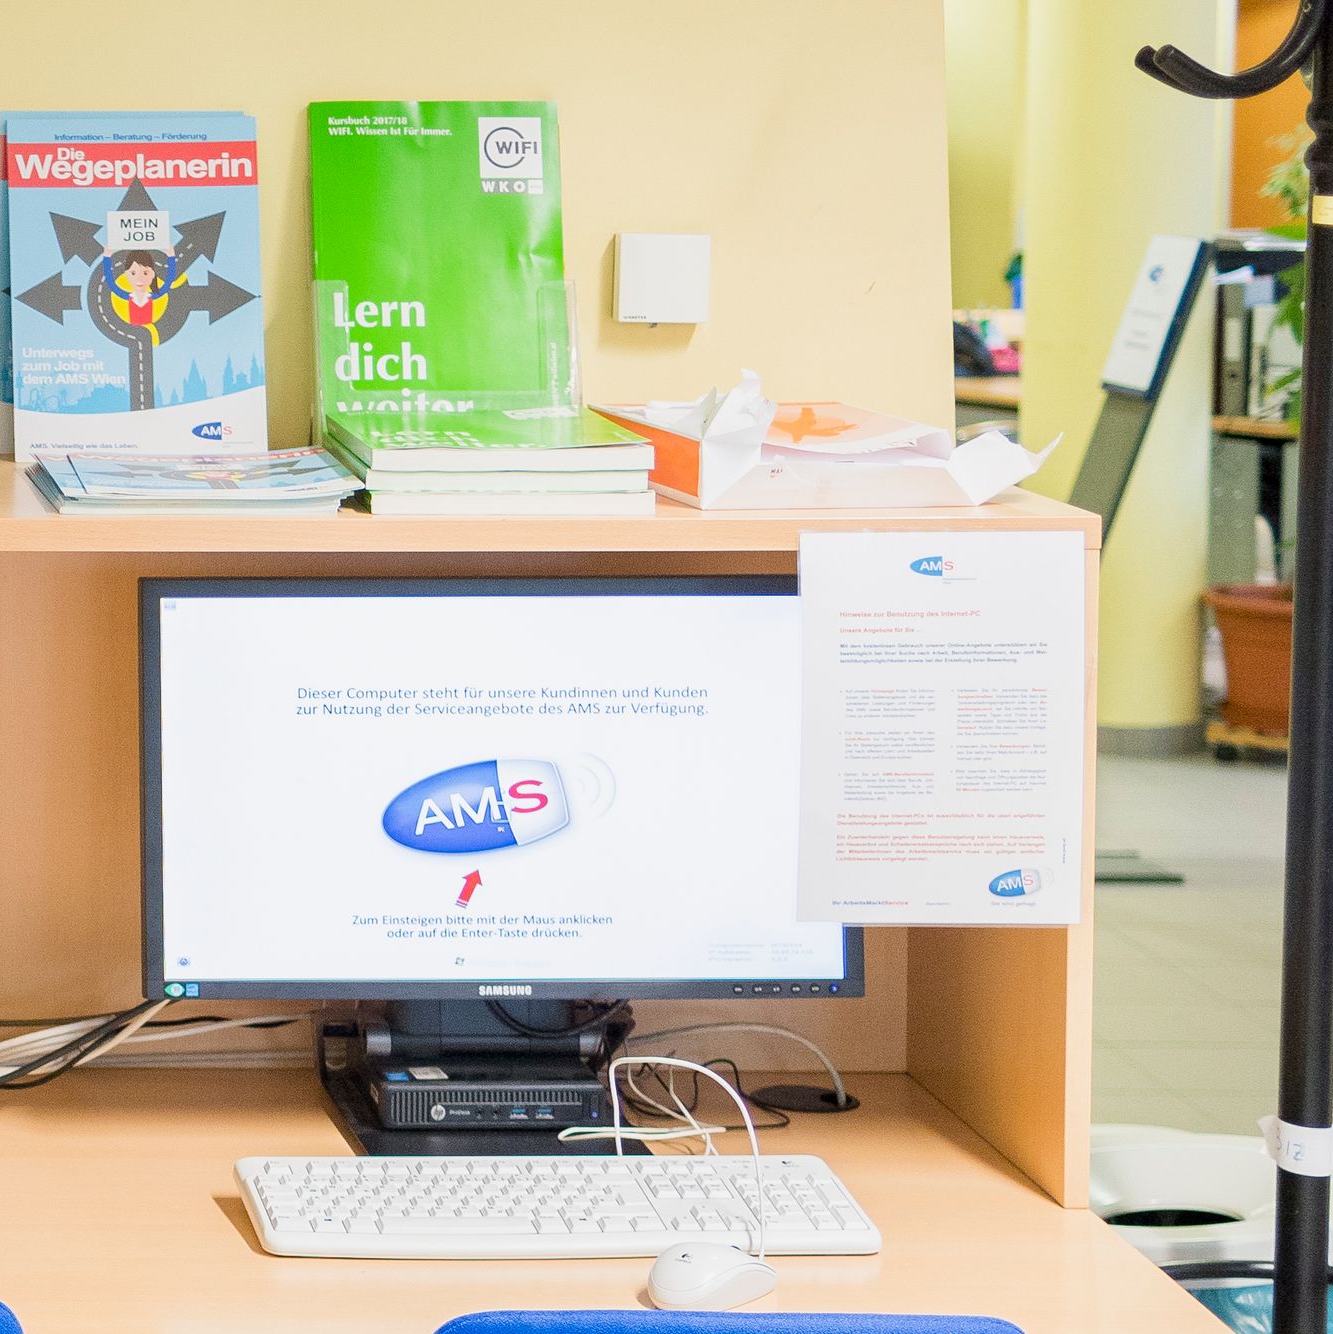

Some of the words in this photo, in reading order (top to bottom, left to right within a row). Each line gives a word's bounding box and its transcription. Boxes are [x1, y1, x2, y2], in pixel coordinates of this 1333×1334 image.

[329, 116, 370, 126] Kursbuch
[373, 115, 409, 125] 2017/18
[54, 133, 104, 141] Information
[112, 133, 153, 142] Beratung
[161, 132, 207, 141] Förderung
[328, 127, 353, 136] WIFI.
[356, 126, 388, 136] Wissen
[389, 126, 401, 136] Ist
[403, 126, 419, 136] Für
[420, 126, 453, 136] Immer.
[495, 140, 538, 154] WIFI
[57, 147, 85, 161] Die
[15, 152, 253, 185] Wegeplanerin
[482, 180, 526, 194] WKO
[121, 219, 157, 228] MEIN
[124, 232, 155, 241] JOB
[333, 291, 426, 328] Lern
[21, 347, 94, 360] Unterwegs
[21, 362, 51, 372] zum
[54, 360, 80, 372] Job
[83, 360, 105, 372] mit
[334, 341, 428, 381] dich
[22, 373, 53, 385] dem
[55, 373, 89, 385] AMS
[90, 373, 127, 385] Wien
[200, 425, 234, 436] AMS
[919, 560, 954, 571] AMS
[839, 611, 872, 619] Hinweise
[886, 610, 925, 619] Benutzung
[940, 609, 981, 617] Internet-PC
[297, 687, 343, 700] Dieser
[346, 687, 419, 702] Computer
[422, 687, 459, 699] steht
[463, 686, 484, 699] für
[488, 689, 536, 699] unsere
[540, 686, 618, 699] Kundinnen
[622, 686, 650, 699] und
[654, 685, 708, 698] Kunden
[296, 705, 318, 715] zur
[322, 703, 382, 718] Nutzung
[386, 703, 411, 715] der
[414, 703, 534, 717] Serviceangebote
[538, 702, 564, 715] des
[567, 703, 600, 714] AMS
[604, 705, 627, 715] zur
[630, 702, 709, 717] Verfügung.
[414, 778, 549, 836] AMS
[352, 915, 379, 925] Zum
[382, 915, 443, 927] Einsteigen
[446, 915, 474, 925] bitte
[476, 915, 496, 925] mit
[499, 914, 520, 925] der
[522, 915, 556, 925] Maus
[558, 914, 613, 925] anklicken
[386, 927, 414, 939] oder
[417, 927, 437, 939] auf
[440, 927, 458, 938] die
[461, 927, 528, 938] Enter-Taste
[531, 927, 582, 938] drücken.
[478, 985, 533, 997] SAMSUNG
